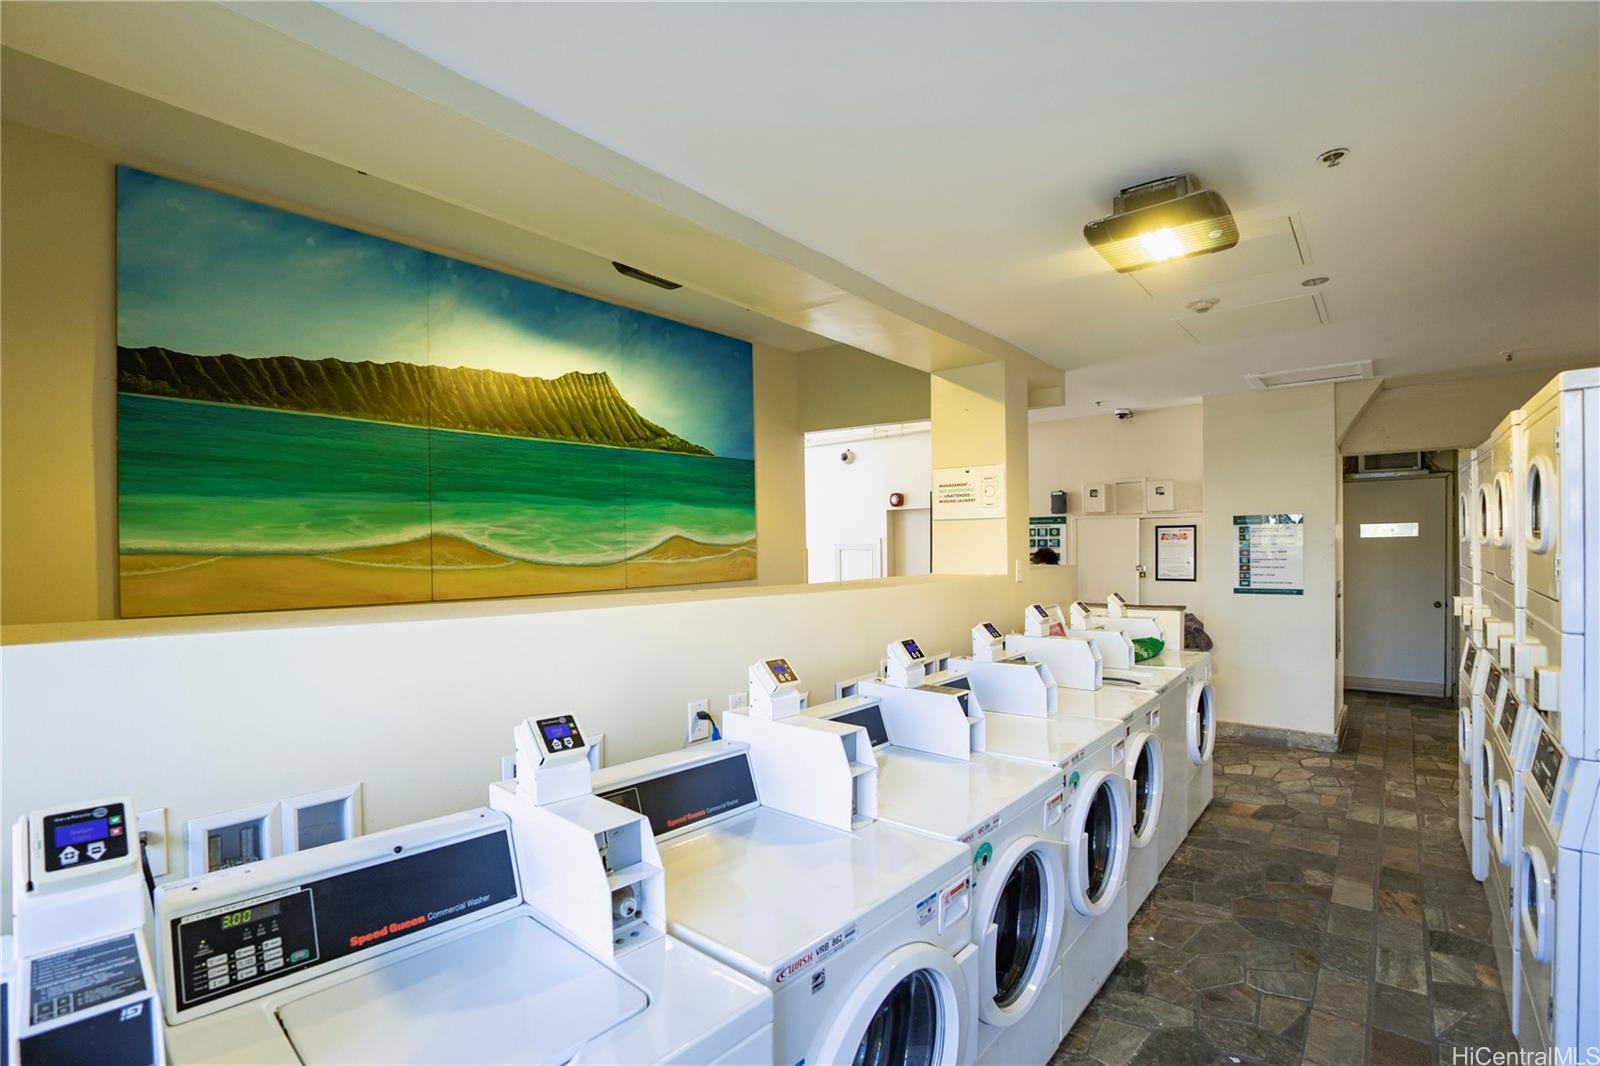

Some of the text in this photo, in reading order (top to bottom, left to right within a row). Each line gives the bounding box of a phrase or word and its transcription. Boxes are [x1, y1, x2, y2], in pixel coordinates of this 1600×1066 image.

[222, 909, 252, 929] 3.00
[350, 894, 490, 947] Speed Queen Commercial Washer
